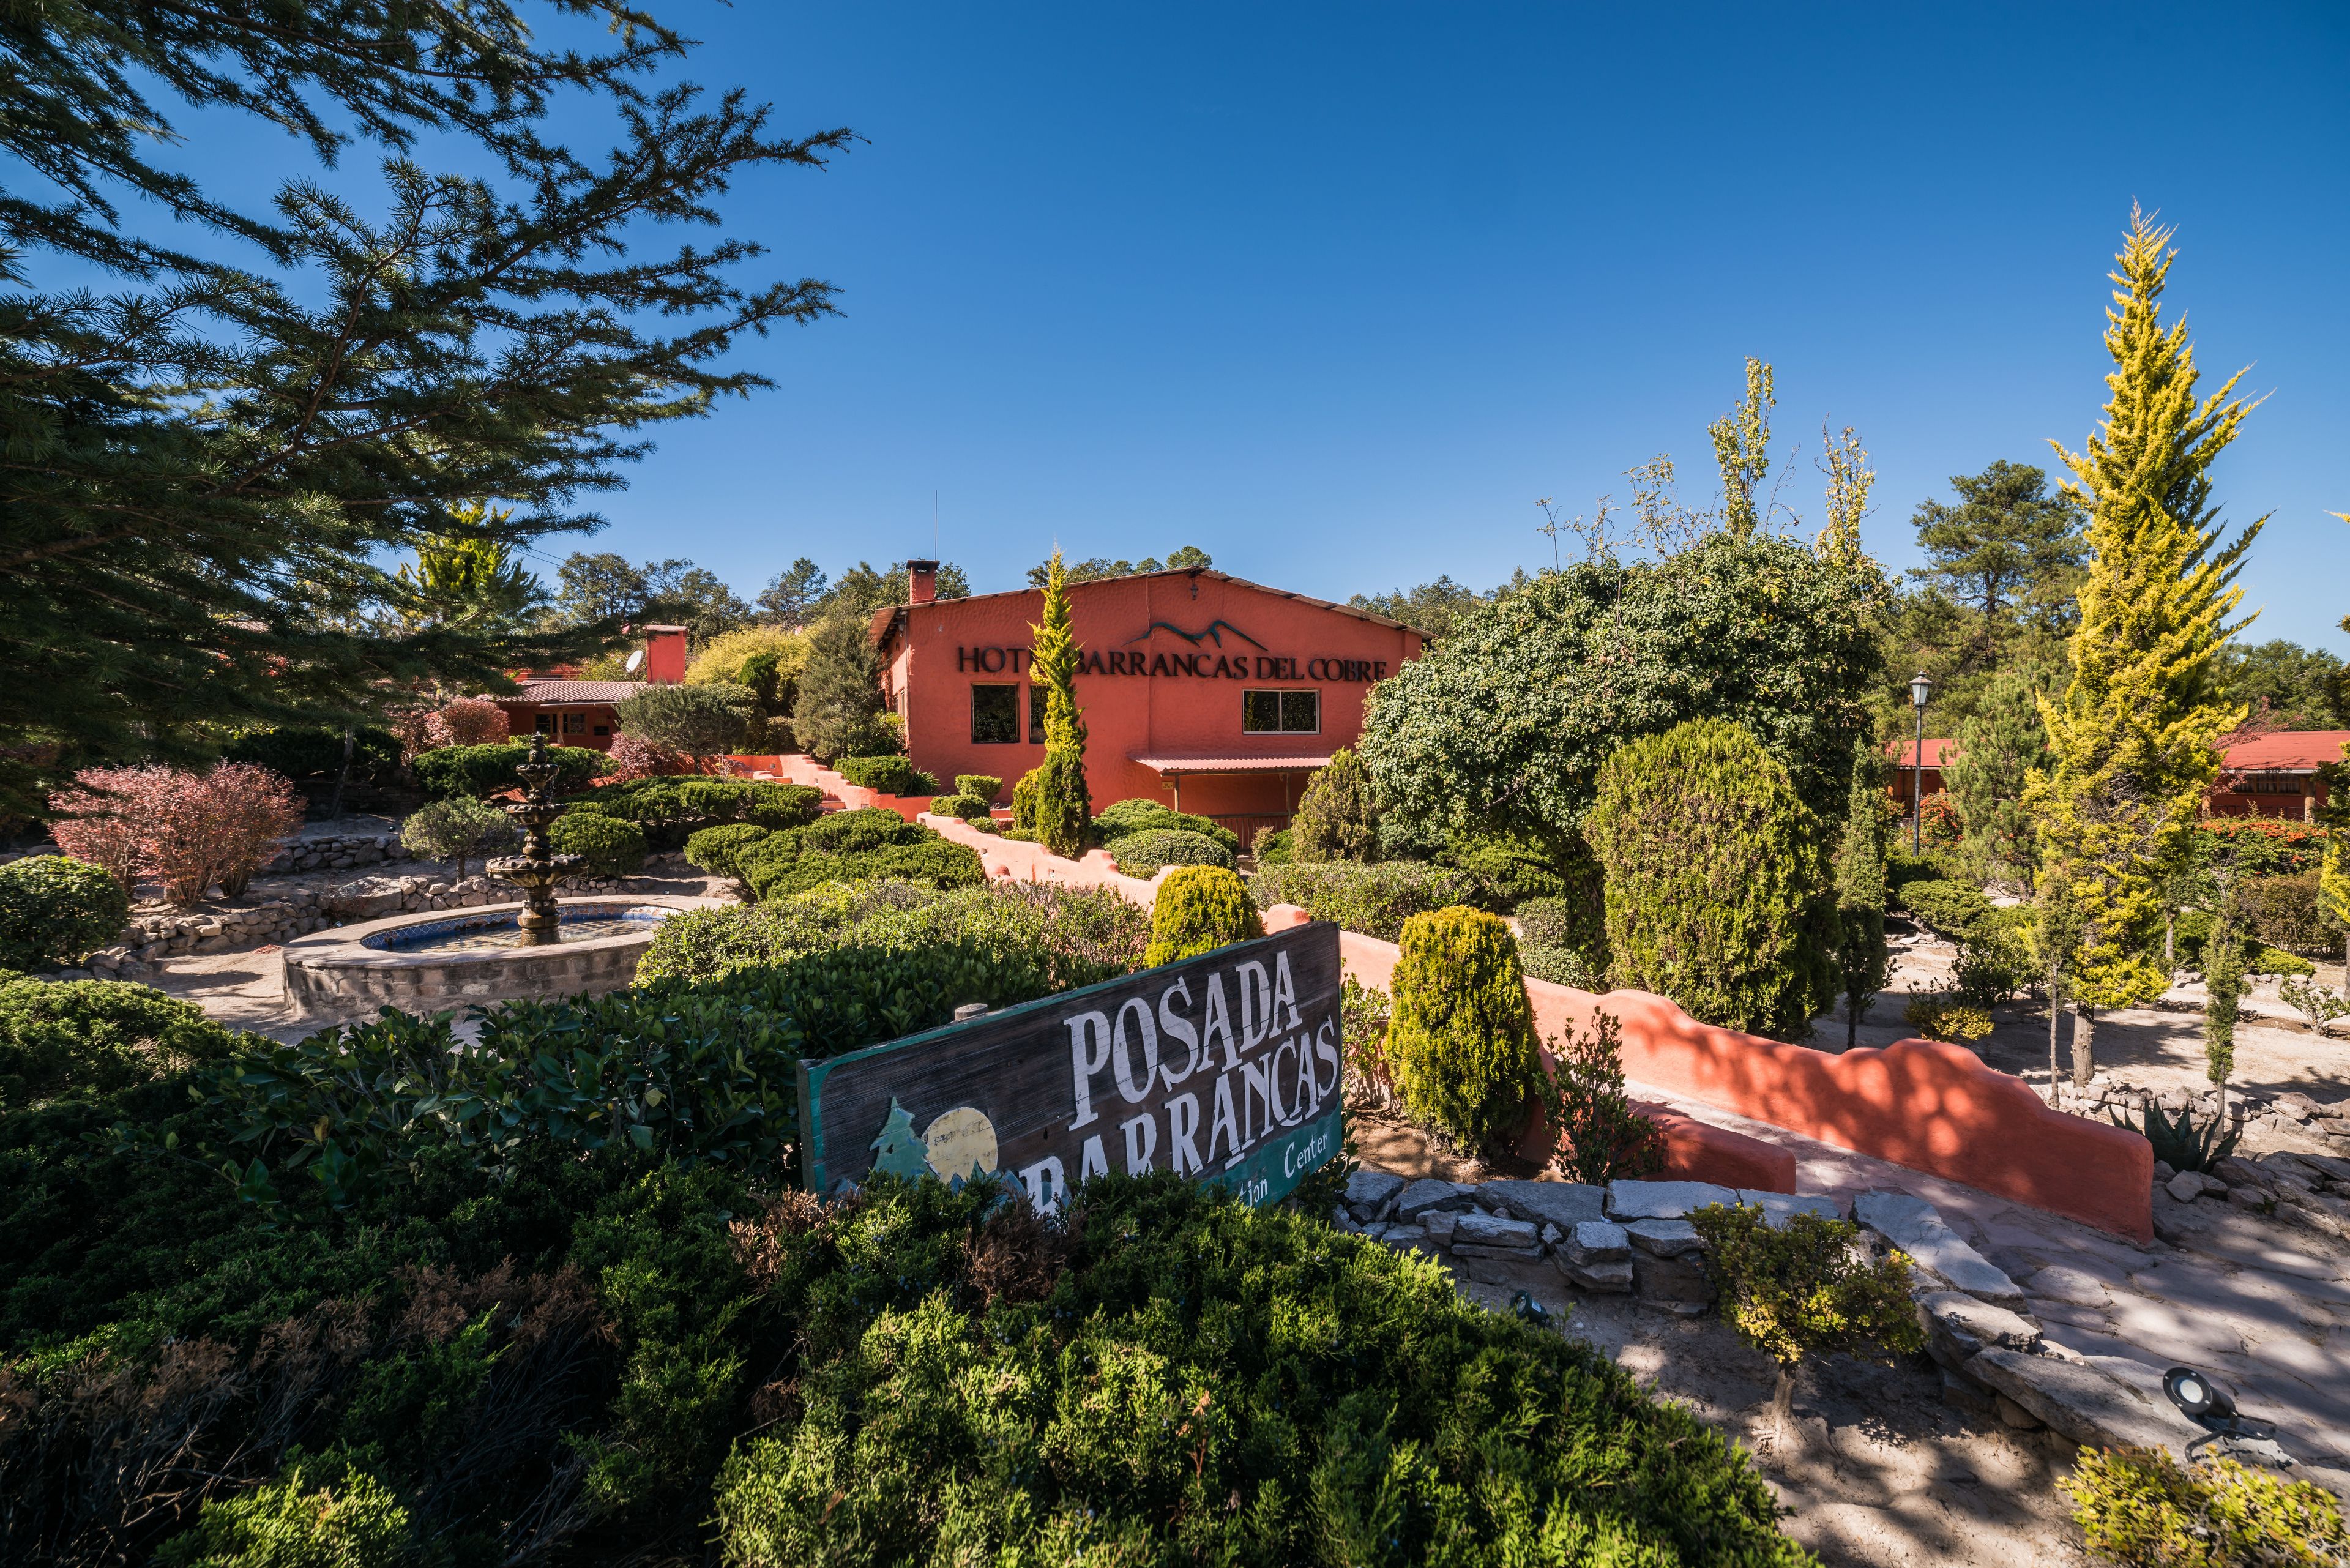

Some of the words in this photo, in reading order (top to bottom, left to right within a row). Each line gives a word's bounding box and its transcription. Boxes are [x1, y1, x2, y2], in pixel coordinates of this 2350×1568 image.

[958, 646, 1044, 673] HOT
[1256, 657, 1305, 680] DEL
[1308, 658, 1387, 682] COBRE
[1064, 950, 1303, 1132] POSADA
[1285, 1132, 1328, 1178] Center
